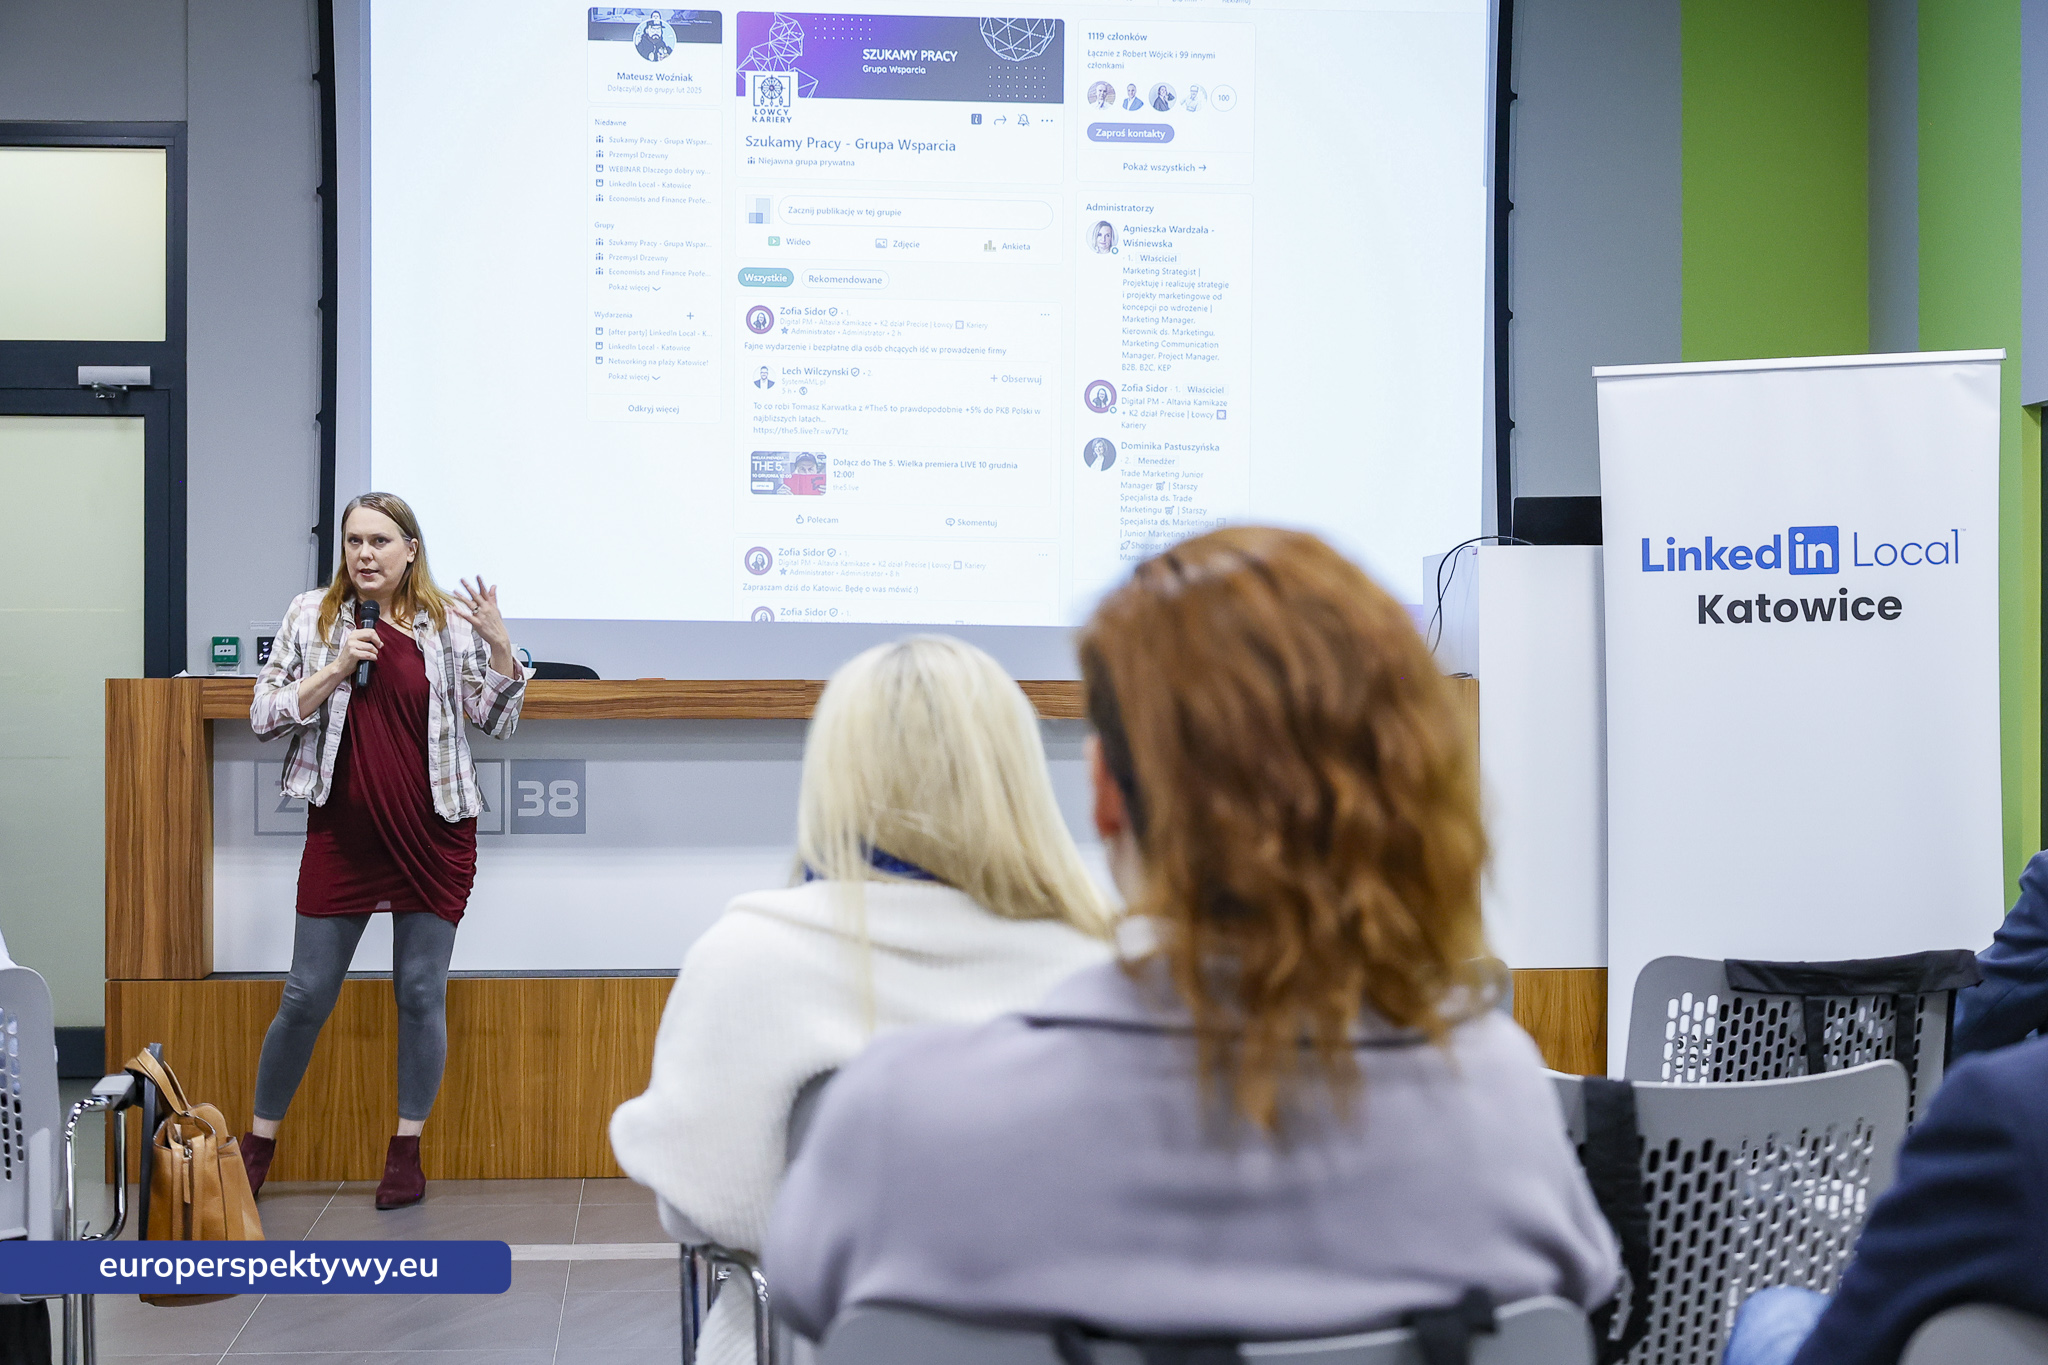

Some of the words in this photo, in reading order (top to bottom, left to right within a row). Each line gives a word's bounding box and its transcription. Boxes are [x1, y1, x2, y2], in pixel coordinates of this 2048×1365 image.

[1088, 32, 1104, 40] 1119
[1106, 32, 1147, 41] członków
[862, 48, 918, 61] SZUKAMY
[921, 50, 958, 62] PRACY
[1087, 49, 1114, 58] Łącznie
[1122, 49, 1146, 58] Robert
[1148, 50, 1173, 60] Wójcik
[1179, 50, 1188, 58] 99
[1190, 51, 1215, 60] innymi
[862, 64, 887, 74] Grupa
[889, 65, 926, 75] Wsparcia
[1087, 61, 1124, 69] członkami
[617, 72, 653, 80] Mateusz
[655, 72, 693, 82] Woźniak
[754, 108, 788, 117] ŁOWCY
[594, 118, 626, 126] Niedawne
[1095, 128, 1126, 139] Zaproś
[1127, 128, 1166, 140] kontakty
[608, 136, 638, 145] Szukamy
[639, 136, 658, 146] Pracy
[663, 137, 684, 146] Grupa
[745, 135, 802, 151] Szukamy
[807, 136, 841, 152] Pracy
[855, 138, 893, 153] Grupa
[897, 138, 955, 154] Wsparcia
[640, 151, 668, 160] Drzewny
[758, 157, 793, 166] Niejawna
[795, 159, 817, 167] grupa
[642, 166, 672, 175] Dlaczego
[674, 167, 694, 176] dobry
[1123, 162, 1148, 171] Pokaż
[1150, 163, 1196, 173] wszystkich
[638, 180, 656, 188] Local
[661, 181, 691, 189] Katowice
[788, 206, 814, 216] Zacznij
[816, 207, 855, 216] publikację
[865, 208, 875, 217] tej
[876, 209, 902, 218] grupie
[1085, 202, 1154, 214] Administratorzy
[594, 221, 614, 230] Grupy
[1122, 224, 1166, 235] Agnieszka
[786, 238, 811, 246] Wideo
[892, 240, 920, 249] Zdjęcie
[1001, 242, 1030, 250] Ankieta
[1122, 238, 1172, 248] Wiśniewska
[1139, 254, 1177, 262] Właściciel
[1122, 267, 1160, 276] Marketing
[1161, 267, 1196, 277] Strategist
[744, 273, 787, 284] Wszystkie
[808, 274, 882, 284] Rekomendowane
[629, 284, 650, 293] więcej
[1122, 278, 1159, 288] Projektuję
[1165, 280, 1196, 289] realizuję
[1197, 281, 1229, 290] strategie
[1126, 291, 1157, 300] projekty
[1158, 292, 1210, 302] marketingowe
[780, 306, 802, 315] Zofia
[804, 307, 826, 316] Sidor
[1122, 303, 1156, 312] koncepcji
[1170, 304, 1208, 312] wdrożenie
[594, 311, 632, 320] Wydarzenia
[744, 341, 763, 351] Fajne
[765, 342, 807, 352] wydarzenie
[812, 343, 849, 352] bezpłatne
[850, 344, 862, 352] dla
[864, 344, 883, 352] osób
[884, 344, 918, 354] chcących
[919, 345, 929, 353] iść
[939, 346, 986, 354] prowadzenie
[987, 346, 1007, 356] firmy
[1121, 339, 1159, 349] Marketing
[1160, 339, 1219, 348] Communication
[608, 357, 647, 367] Networking
[782, 366, 802, 375] Lech
[1001, 374, 1042, 385] Obserwuj
[1121, 383, 1143, 392] Zofia
[1145, 383, 1168, 392] Sidor
[1187, 386, 1224, 394] Właściciel
[1121, 397, 1145, 406] Digital
[1166, 398, 1191, 406] Altavia
[1193, 398, 1228, 406] Kamikaze
[627, 404, 654, 414] Odkryj
[655, 405, 679, 414] więcej
[753, 401, 762, 410] To
[791, 402, 819, 410] Tomasz
[821, 403, 857, 411] Karwatka
[899, 405, 963, 414] prawdopodobnie
[983, 406, 993, 414] do
[1011, 406, 1032, 414] Polski
[1120, 441, 1162, 450] Dominika
[1164, 442, 1219, 453] Pastuszyńska
[752, 461, 774, 471] THE
[833, 458, 858, 467] Dołącz
[872, 459, 887, 467] The
[924, 461, 958, 469] premiera
[960, 460, 976, 468] LIVE
[988, 461, 1018, 470] grudnia
[807, 515, 838, 524] Polecam
[957, 518, 997, 528] Skomentuj
[1853, 529, 1960, 568] Local
[742, 582, 782, 592] Zapraszam
[800, 584, 810, 592] do
[845, 584, 864, 594] Będę
[888, 585, 912, 593] mówić
[1698, 587, 1903, 625] Katowice
[517, 779, 579, 817] 38
